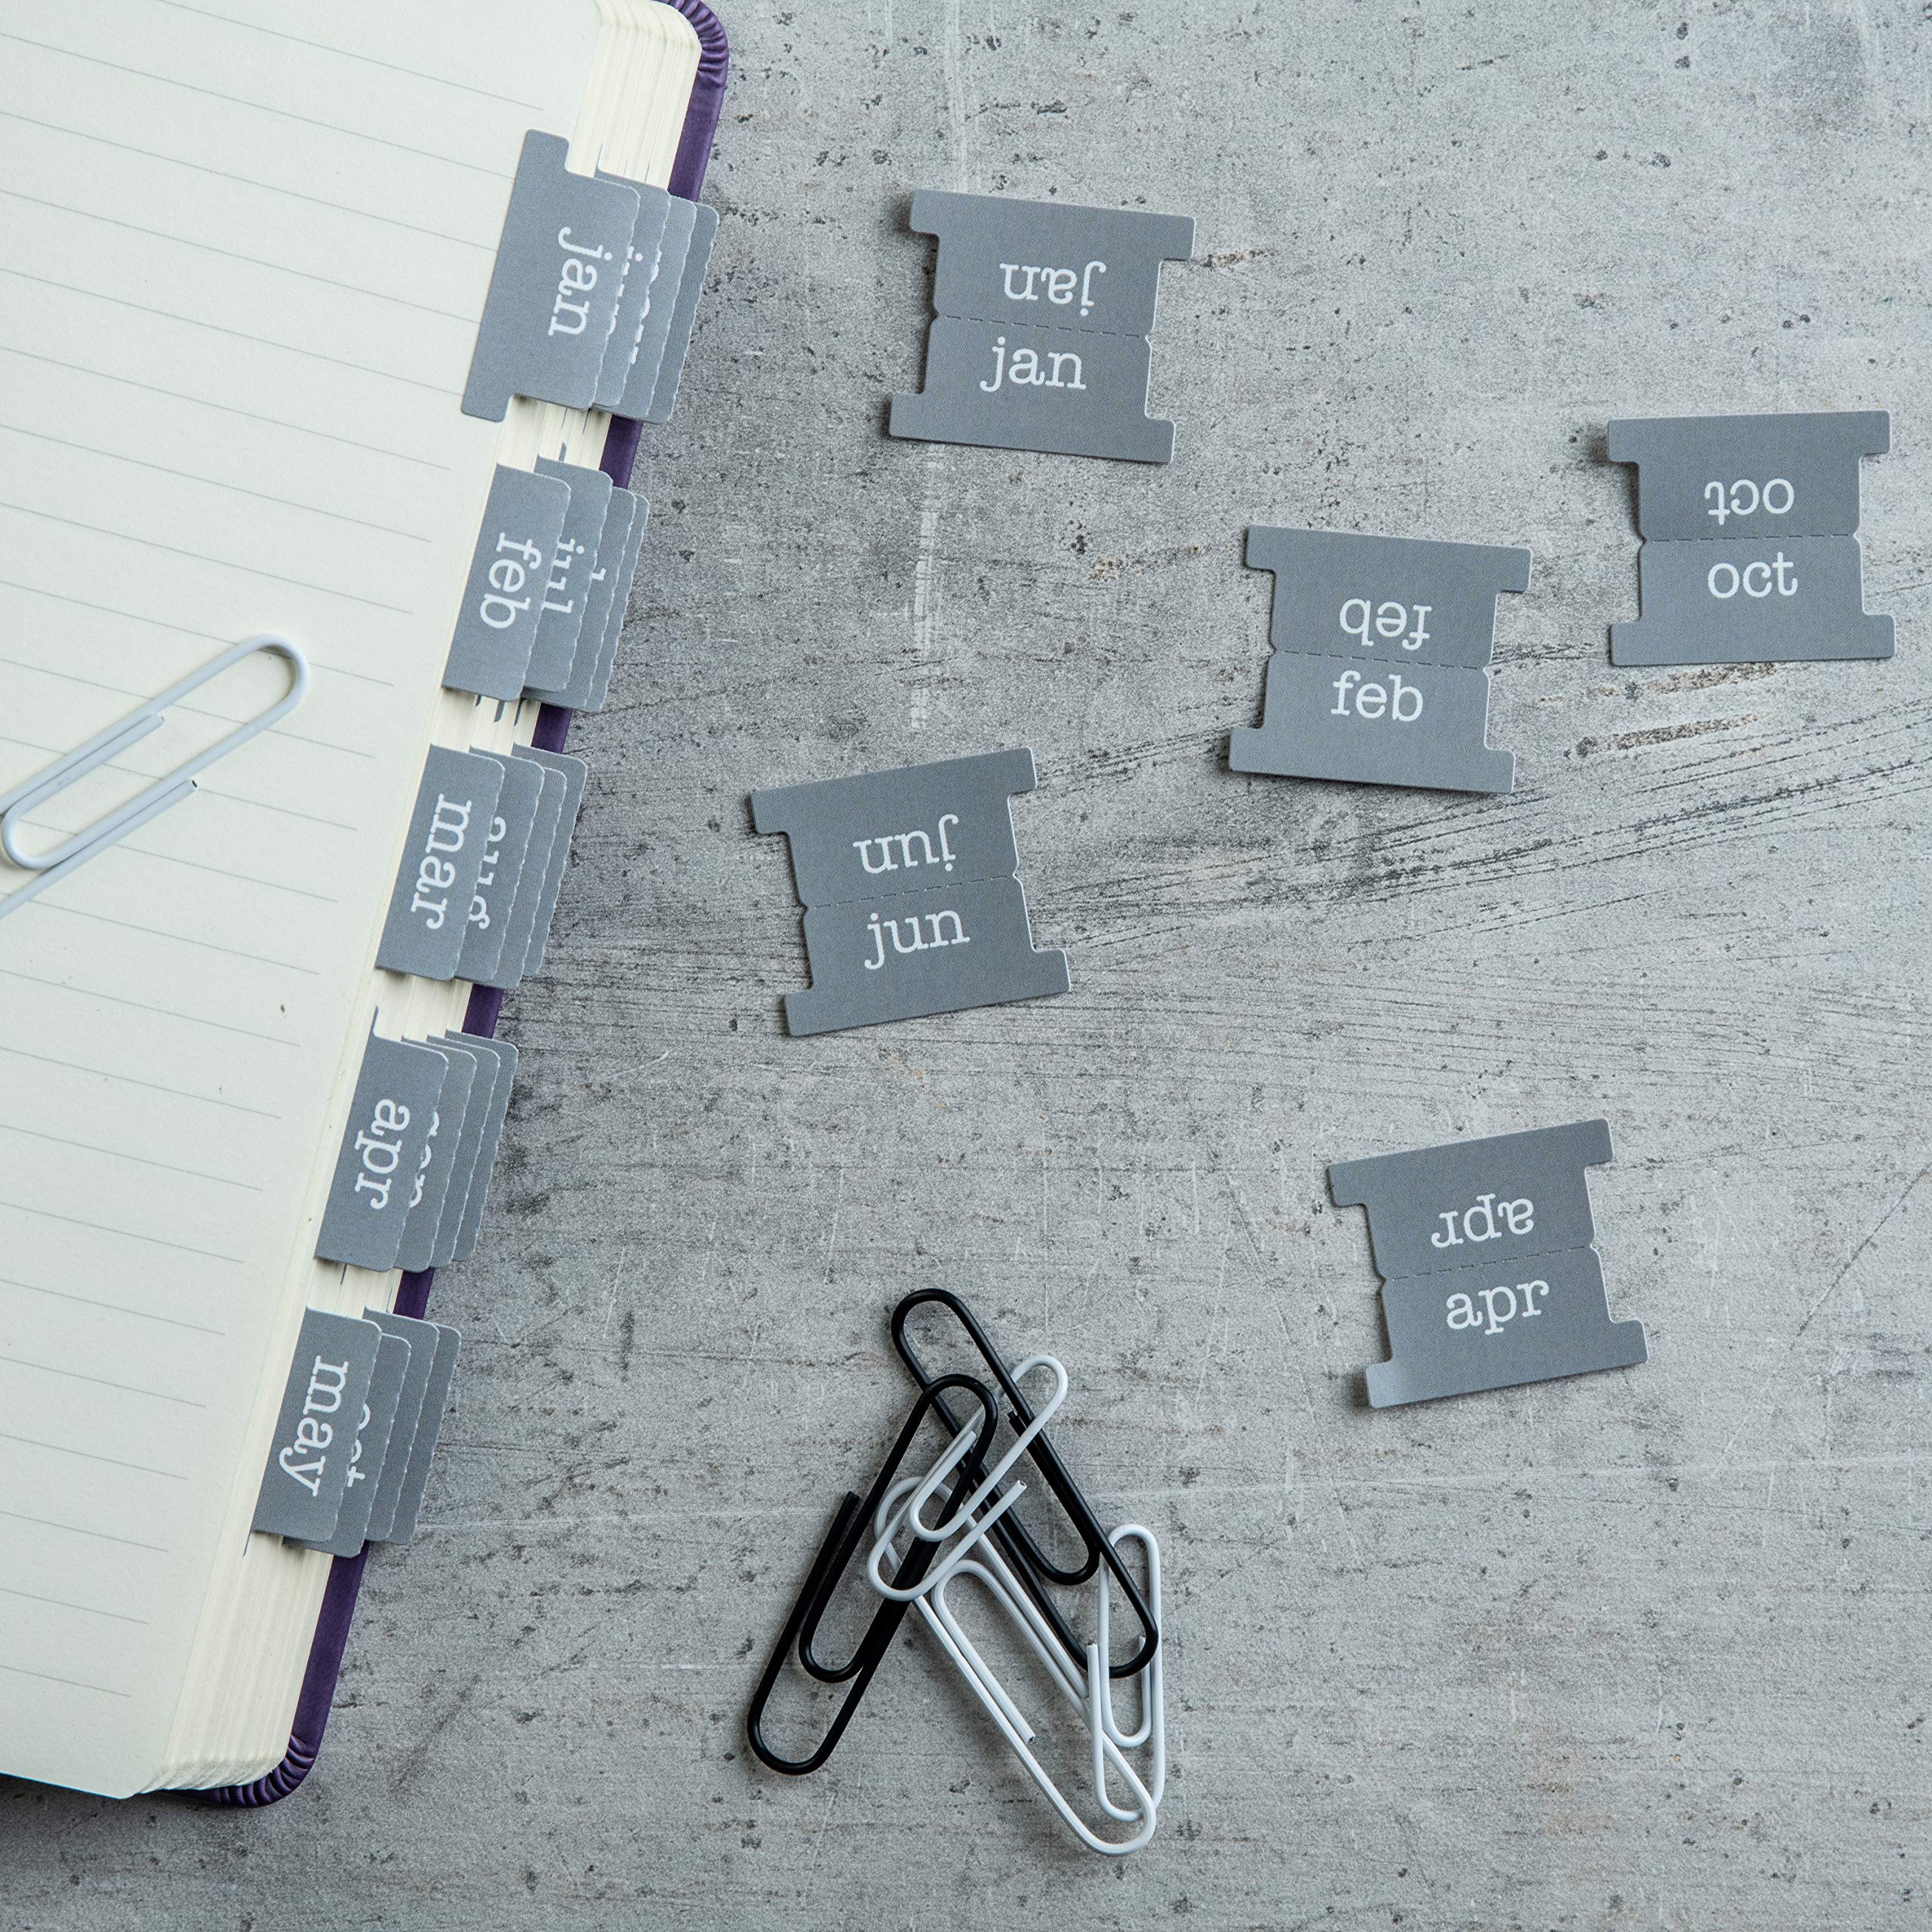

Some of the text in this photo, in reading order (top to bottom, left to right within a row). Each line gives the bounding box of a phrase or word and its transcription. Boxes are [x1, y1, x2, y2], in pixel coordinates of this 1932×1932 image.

[547, 226, 613, 337] jan
[999, 261, 1106, 316] jan
[980, 337, 1086, 392] jan
[1704, 478, 1794, 525] oct
[479, 531, 542, 629] feb
[1708, 552, 1798, 598] oct
[1340, 598, 1432, 650] feb
[1331, 670, 1423, 721] feb
[409, 792, 472, 929] mar
[853, 814, 958, 873] jun
[864, 911, 971, 969] jun
[354, 1098, 411, 1209] apr
[1431, 1194, 1534, 1247] apr
[1447, 1280, 1549, 1334] apr
[278, 1355, 349, 1497] may
